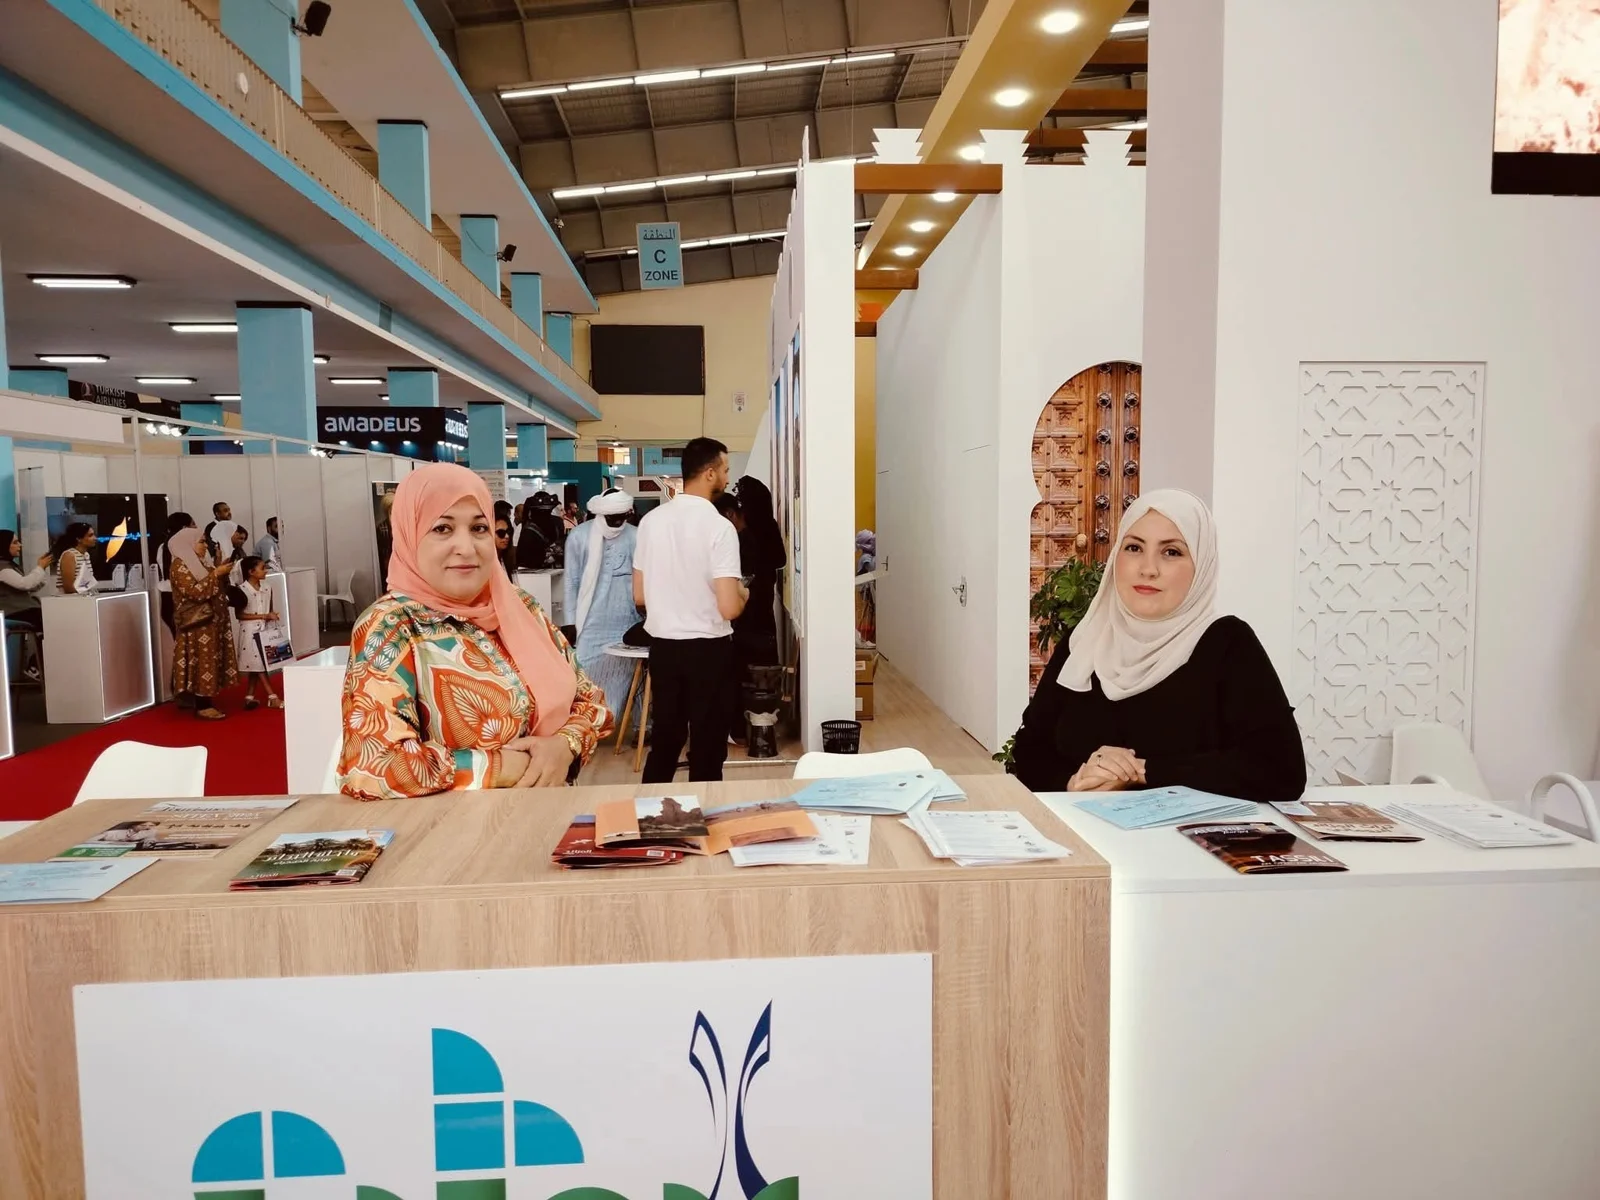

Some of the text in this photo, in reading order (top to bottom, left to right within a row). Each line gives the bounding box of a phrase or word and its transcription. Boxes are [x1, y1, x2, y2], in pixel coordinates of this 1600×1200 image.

[654, 249, 667, 263] C
[645, 270, 679, 281] ZONE
[95, 384, 126, 398] TURKISH
[95, 395, 128, 410] AIRLINES
